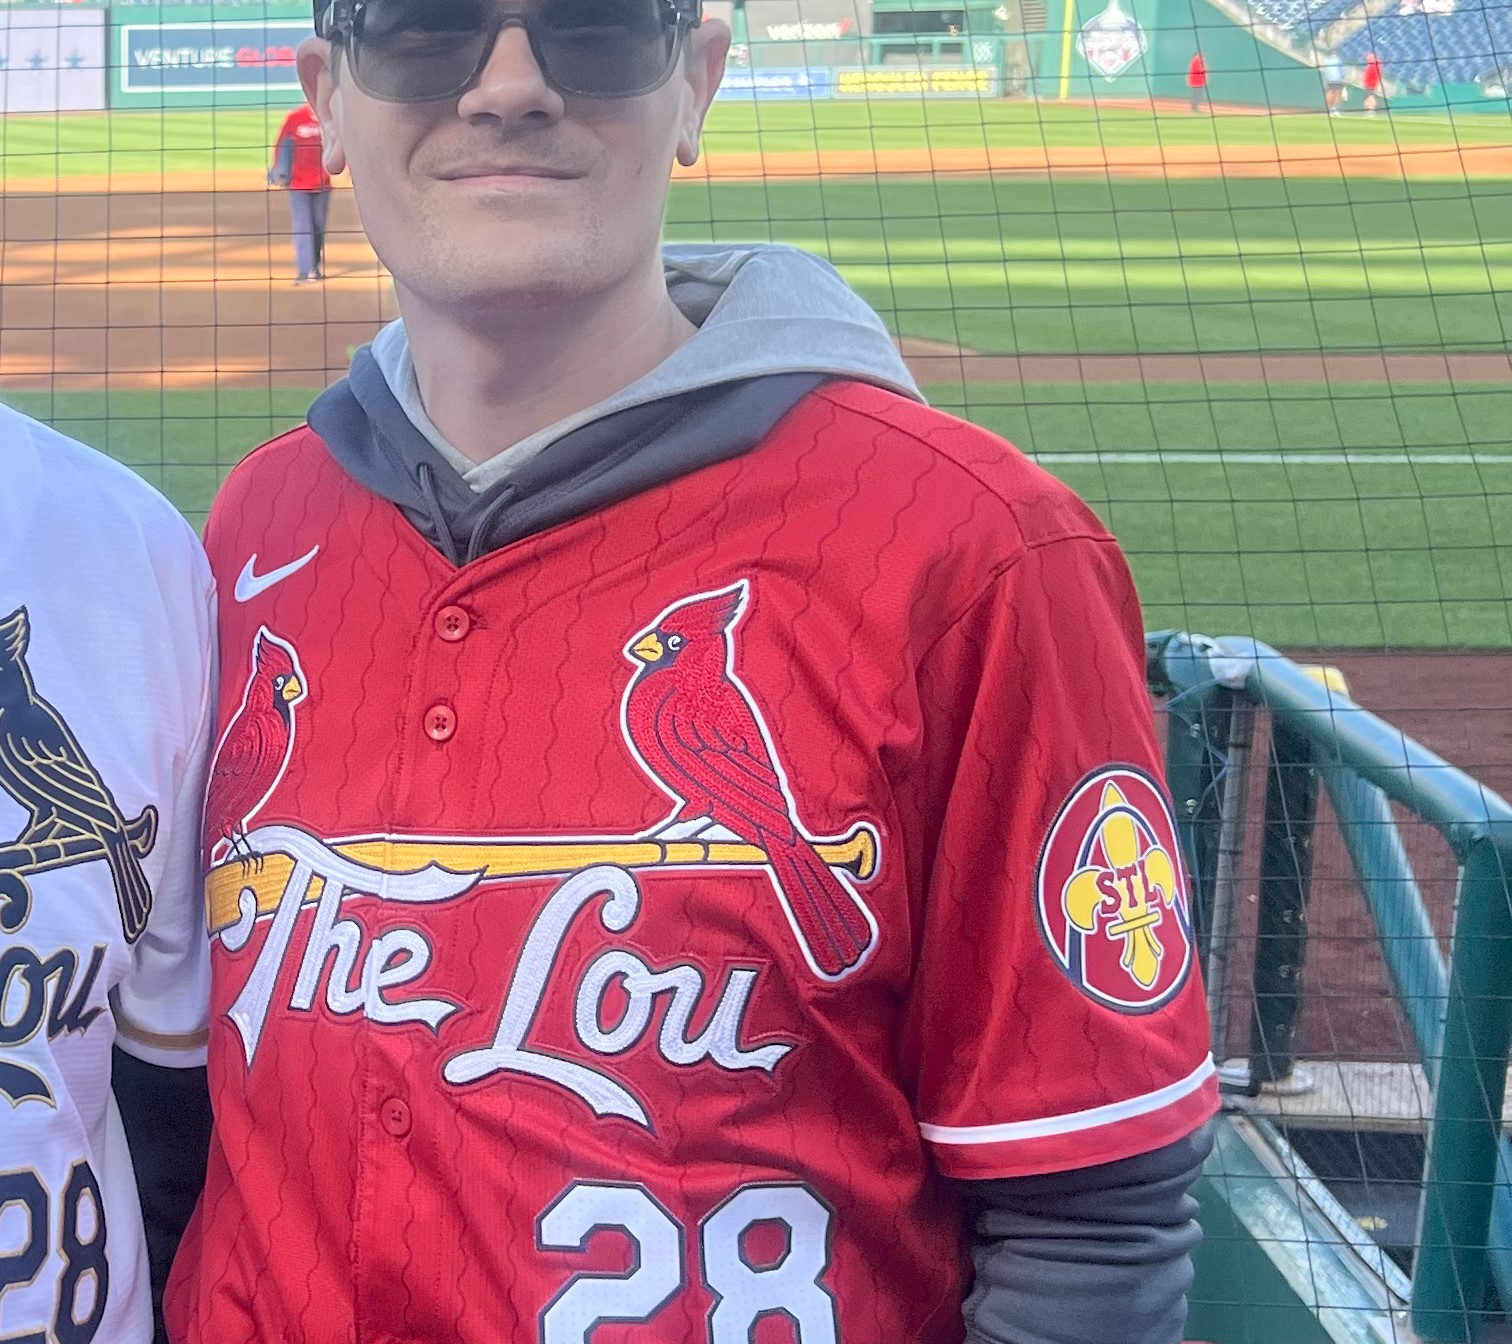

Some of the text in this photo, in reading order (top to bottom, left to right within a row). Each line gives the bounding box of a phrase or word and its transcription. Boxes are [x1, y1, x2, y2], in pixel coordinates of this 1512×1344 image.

[134, 47, 235, 69] VENTURE
[1096, 859, 1159, 915] STL
[210, 826, 793, 1134] The Lou
